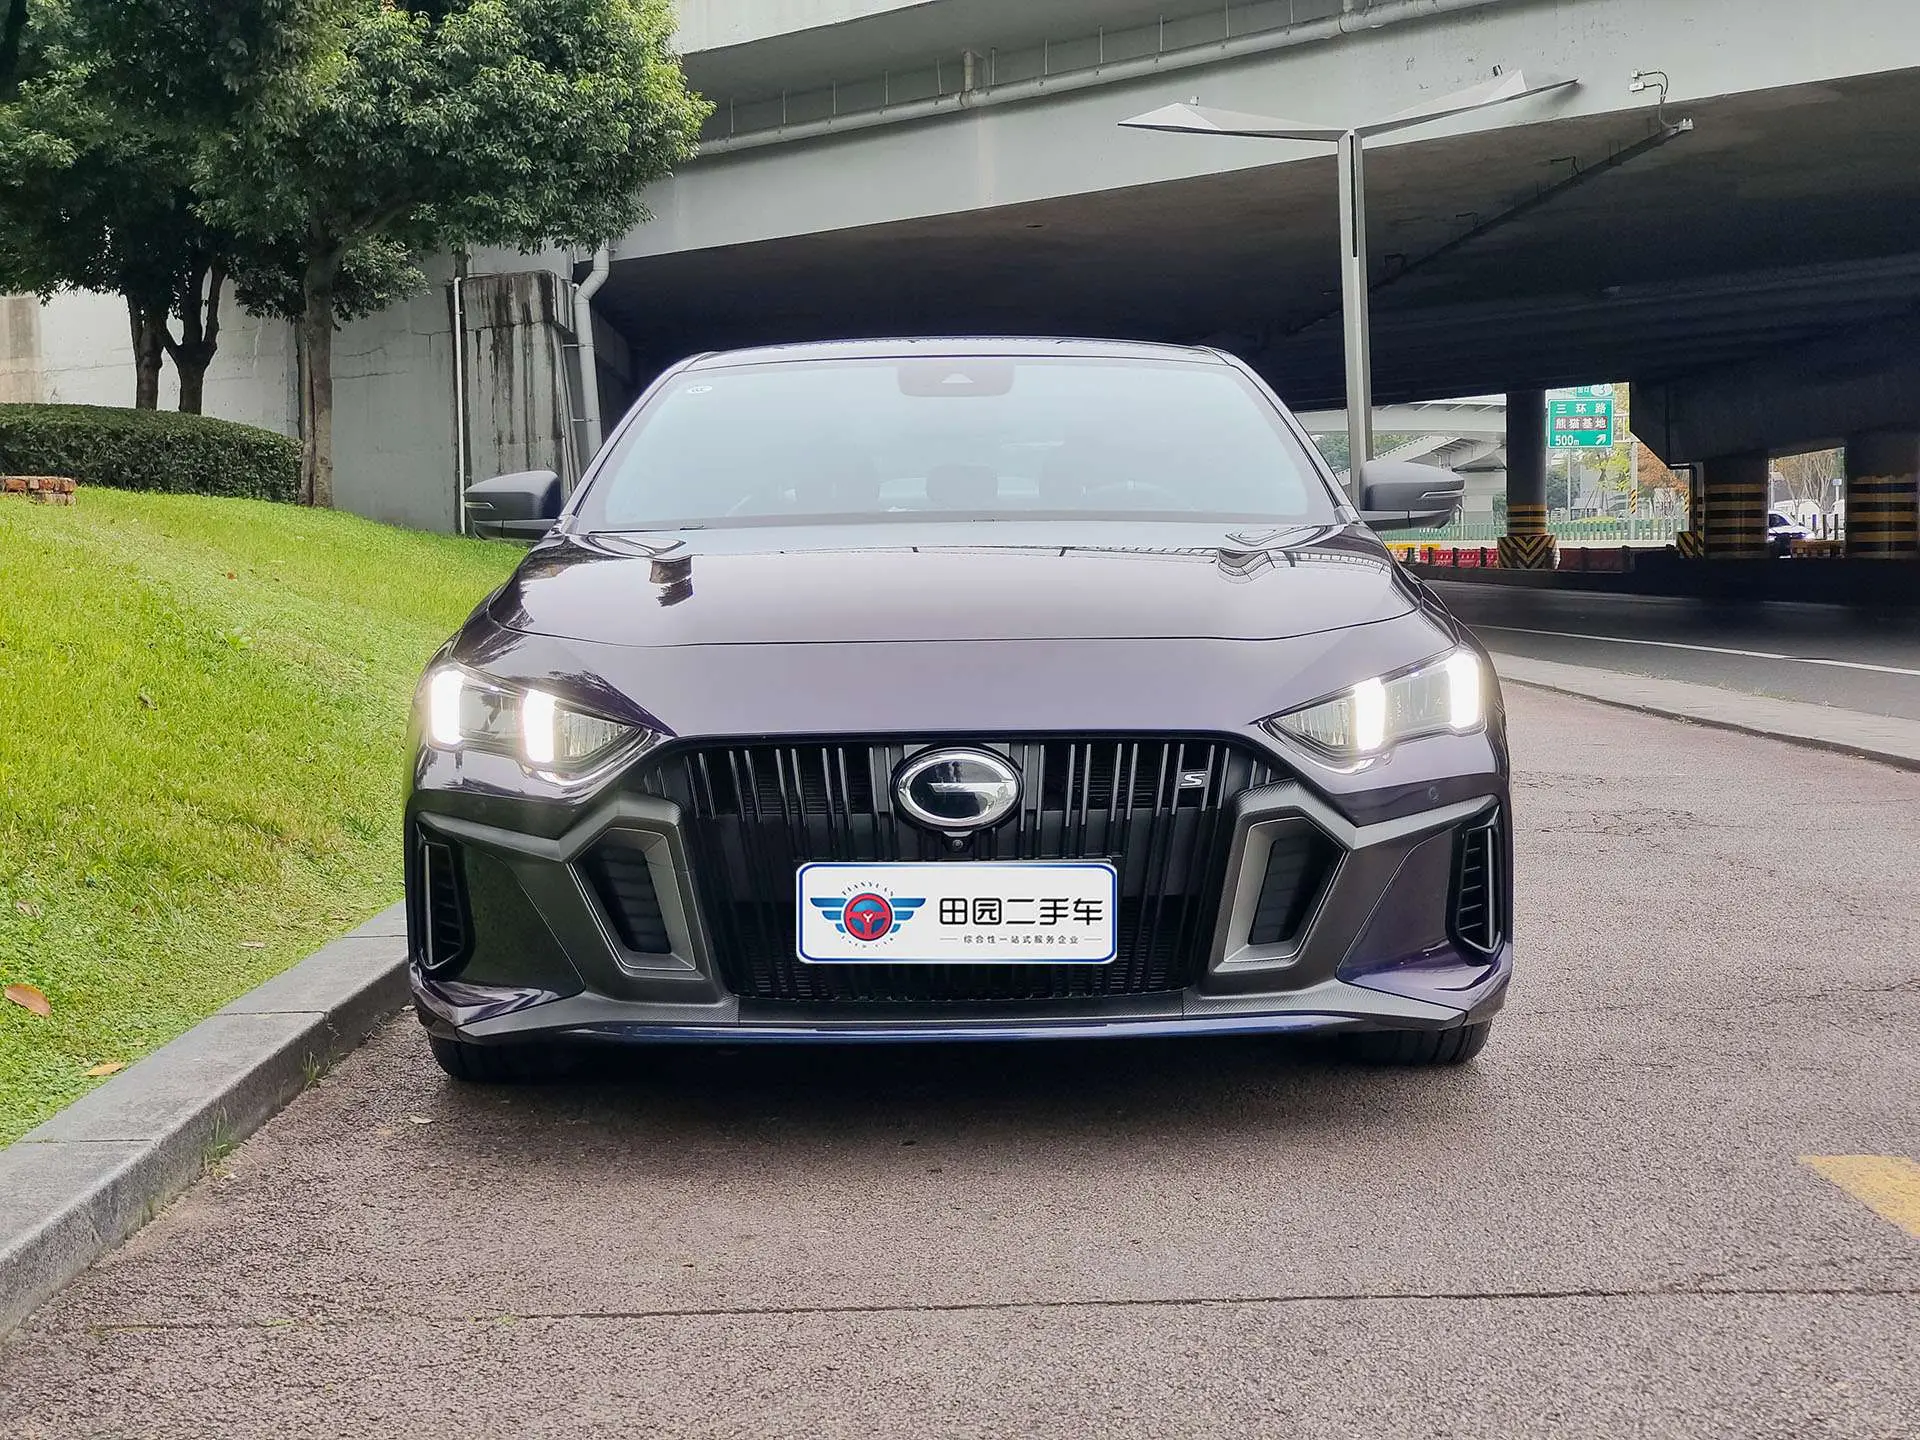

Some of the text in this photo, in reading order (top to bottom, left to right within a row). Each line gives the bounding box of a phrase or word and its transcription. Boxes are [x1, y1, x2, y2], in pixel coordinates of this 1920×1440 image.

[1555, 402, 1606, 414] 三环路
[1555, 417, 1606, 430] 熊猫基地
[1555, 434, 1580, 446] 500m
[939, 898, 1103, 925] 田园二手车
[863, 913, 873, 923] Y
[963, 935, 1079, 945] 综合性一站式服务企业
